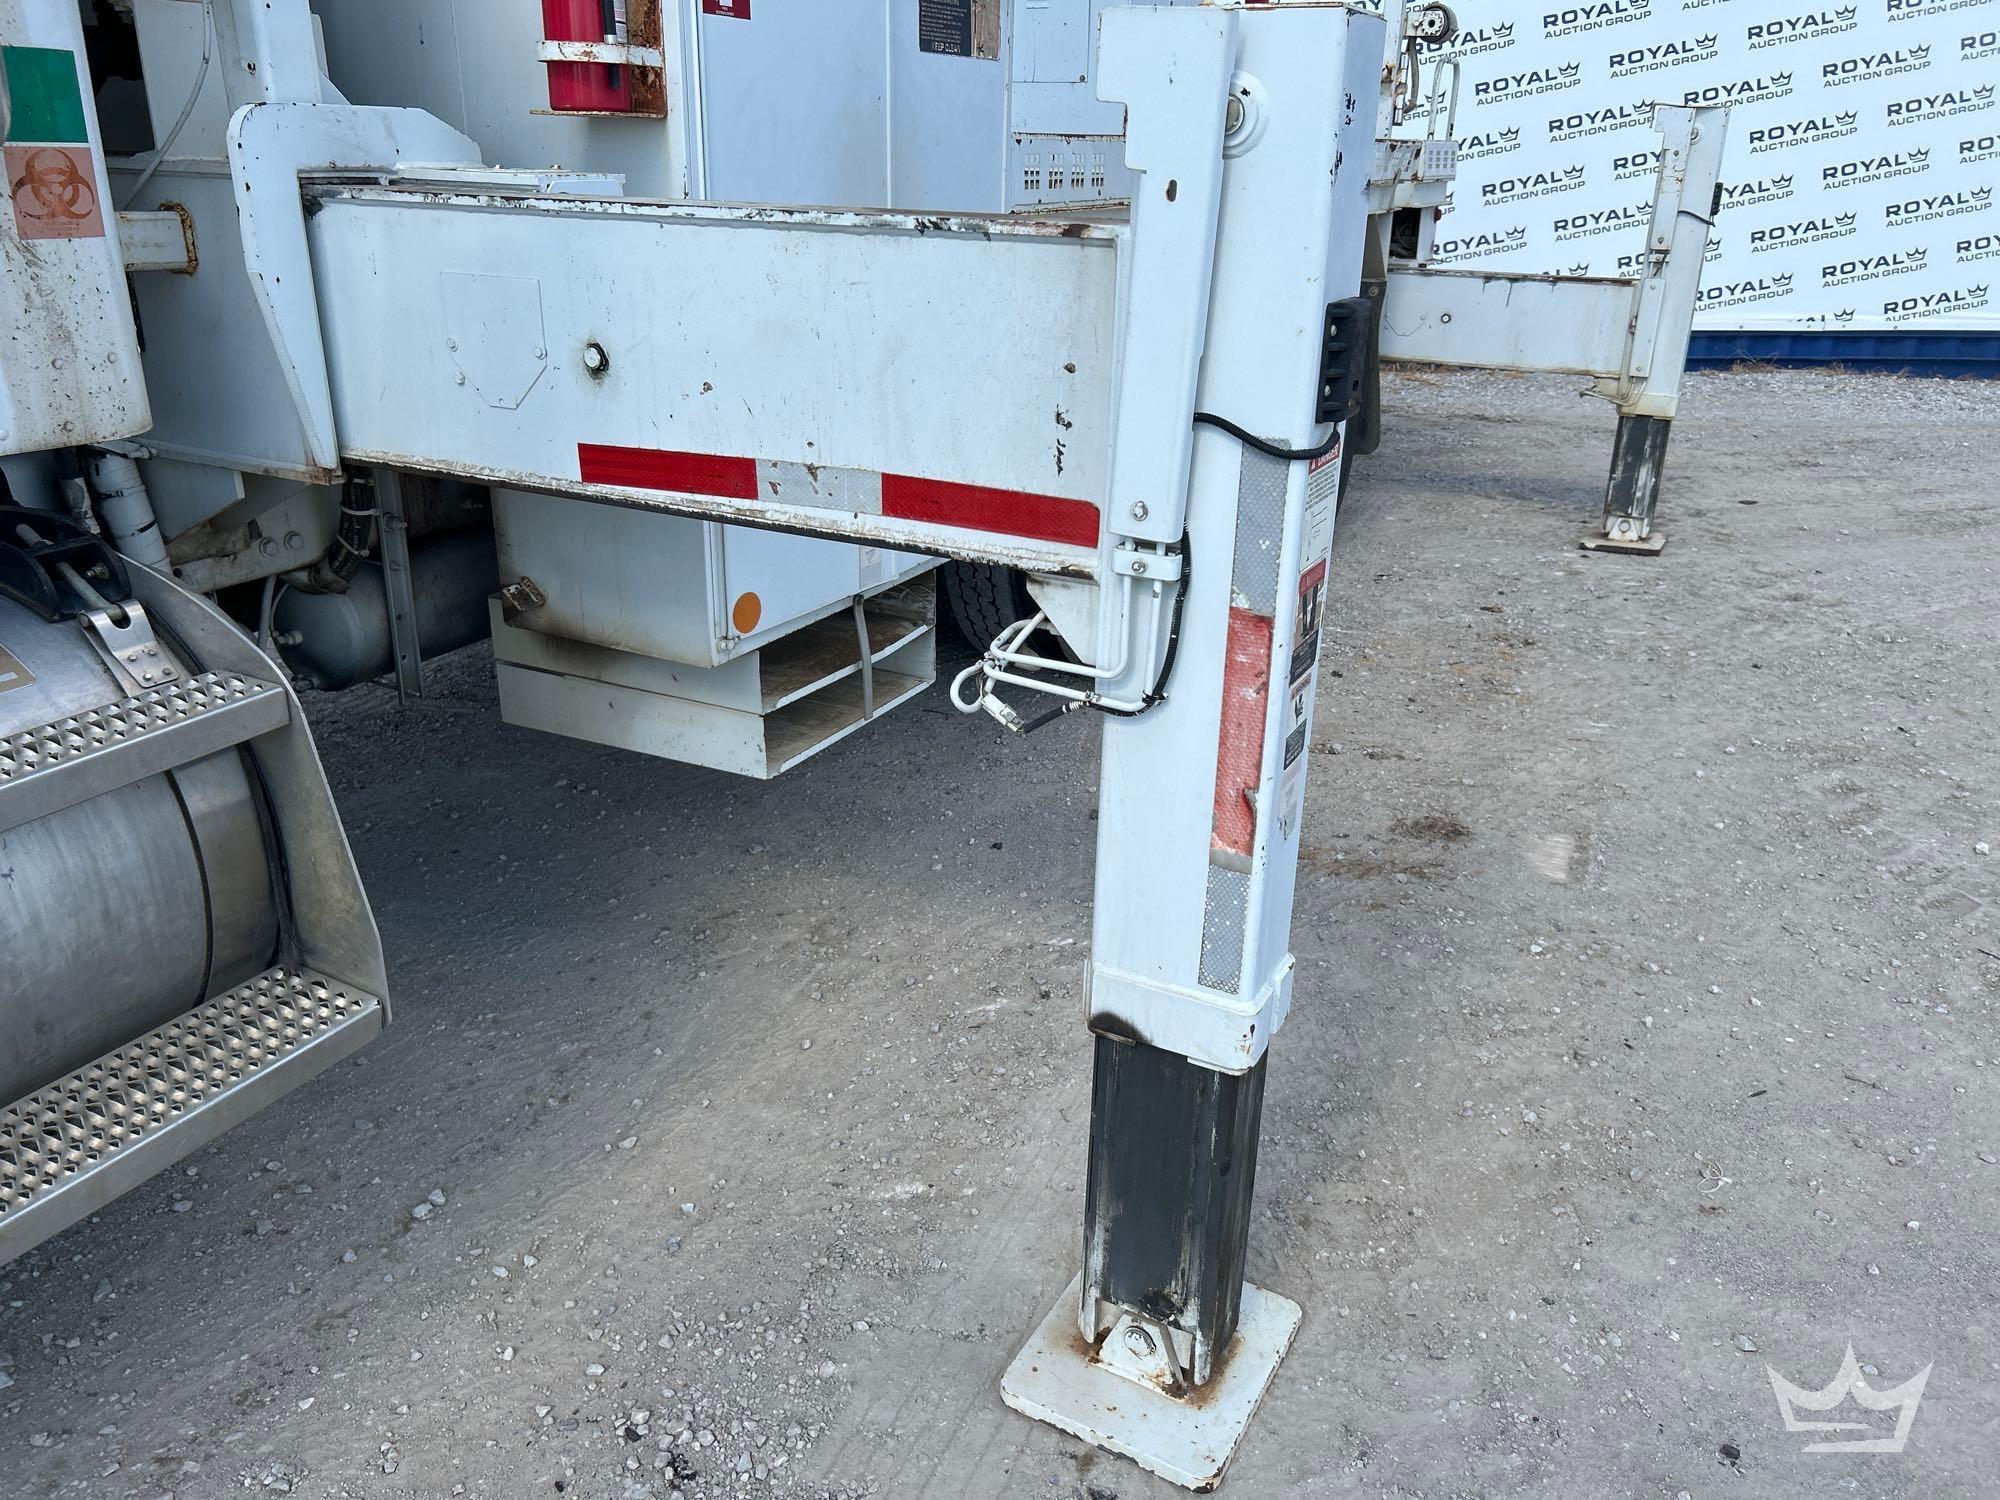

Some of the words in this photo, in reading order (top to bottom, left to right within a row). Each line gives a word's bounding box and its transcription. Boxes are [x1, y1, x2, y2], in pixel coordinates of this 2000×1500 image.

[1543, 0, 1628, 29] ROYAL
[1544, 21, 1602, 39] AUCTION
[1605, 10, 1652, 27] GROUP
[1748, 12, 1834, 40] ROYAL
[1887, 5, 1947, 23] AUCTION
[1748, 32, 1808, 51] AUCTION
[1811, 23, 1858, 38] GROUP
[1419, 49, 1467, 66] UCTION
[1470, 39, 1515, 55] GROUP
[1609, 40, 1694, 68] ROYAL
[1610, 60, 1669, 79] AUCTION
[1671, 50, 1718, 66] GROUP
[1823, 51, 1908, 77] ROYAL
[1960, 47, 2000, 61] AUCTI
[1475, 68, 1558, 96] ROYAL
[1823, 70, 1882, 88] AUCTION
[1884, 60, 1931, 76] GROUP
[1476, 88, 1533, 106] AUCTION
[1536, 78, 1581, 94] GROUP
[1684, 78, 1769, 106] ROYAL
[1746, 88, 1793, 103] GROUP
[1887, 91, 1972, 117] ROYAL
[1403, 107, 1447, 121] GROP
[1548, 106, 1632, 133] ROYAL
[1888, 109, 1946, 127] AUCTION
[1948, 101, 1995, 116] GROUP
[1458, 133, 1498, 151] YAL
[1549, 126, 1607, 143] AUCTION
[1750, 117, 1834, 144] ROYAL
[1750, 137, 1809, 154] AUCTION
[1812, 127, 1858, 142] GROUP
[1477, 143, 1520, 158] GROUP
[1613, 151, 1662, 171] ROY
[1960, 151, 2000, 164] AUCTI
[1614, 166, 1660, 181] AUCTIO
[1823, 154, 1907, 180] ROYAL
[1823, 172, 1881, 190] AUCTION
[1884, 163, 1929, 179] GROUP
[1482, 171, 1562, 197] ROYAL
[1483, 189, 1538, 207] AUCTION
[1541, 180, 1585, 195] GROUP
[1723, 181, 1770, 198] YAL
[1748, 190, 1793, 204] GROUP
[1886, 192, 1969, 218] ROYAL
[1886, 211, 1944, 228] AUCTION
[1946, 202, 1992, 216] GROUP
[1554, 205, 1635, 232] ROYAL
[1555, 225, 1611, 242] AUCTION
[1613, 217, 1650, 232] GROU
[1751, 218, 1834, 244] ROYAL
[1484, 241, 1527, 256] GROUP
[1751, 236, 1808, 253] AUCTION
[1811, 227, 1857, 242] GROUP
[1822, 254, 1905, 278] ROYAL
[1822, 271, 1880, 288] AUCTION
[1882, 262, 1928, 277] GROUP
[1749, 288, 1794, 302] GROUP
[1883, 290, 1966, 314] ROYAL
[1885, 308, 1941, 321] AUCTION
[1943, 299, 1989, 313] GROUP
